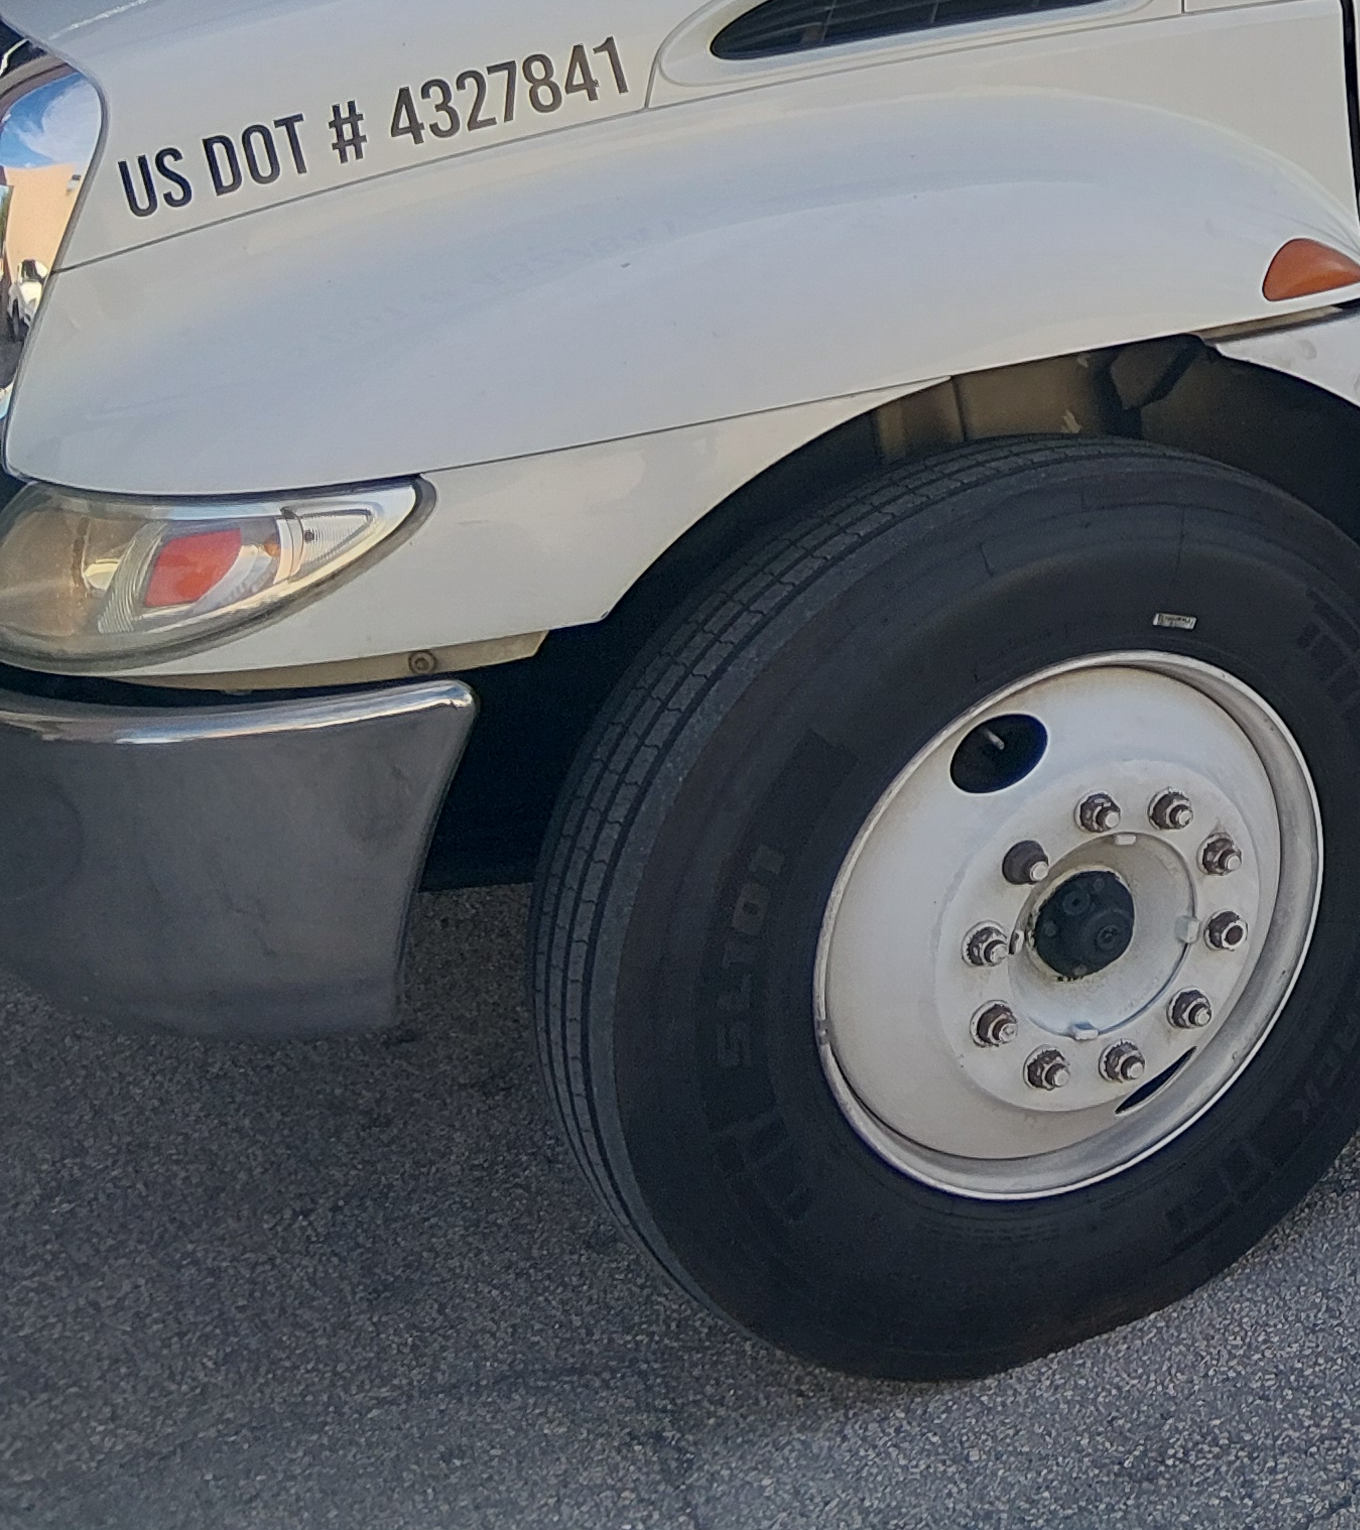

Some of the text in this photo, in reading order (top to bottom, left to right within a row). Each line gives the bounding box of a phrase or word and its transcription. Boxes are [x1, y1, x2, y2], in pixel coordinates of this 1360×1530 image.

[117, 36, 629, 218] US DOT # 4327841
